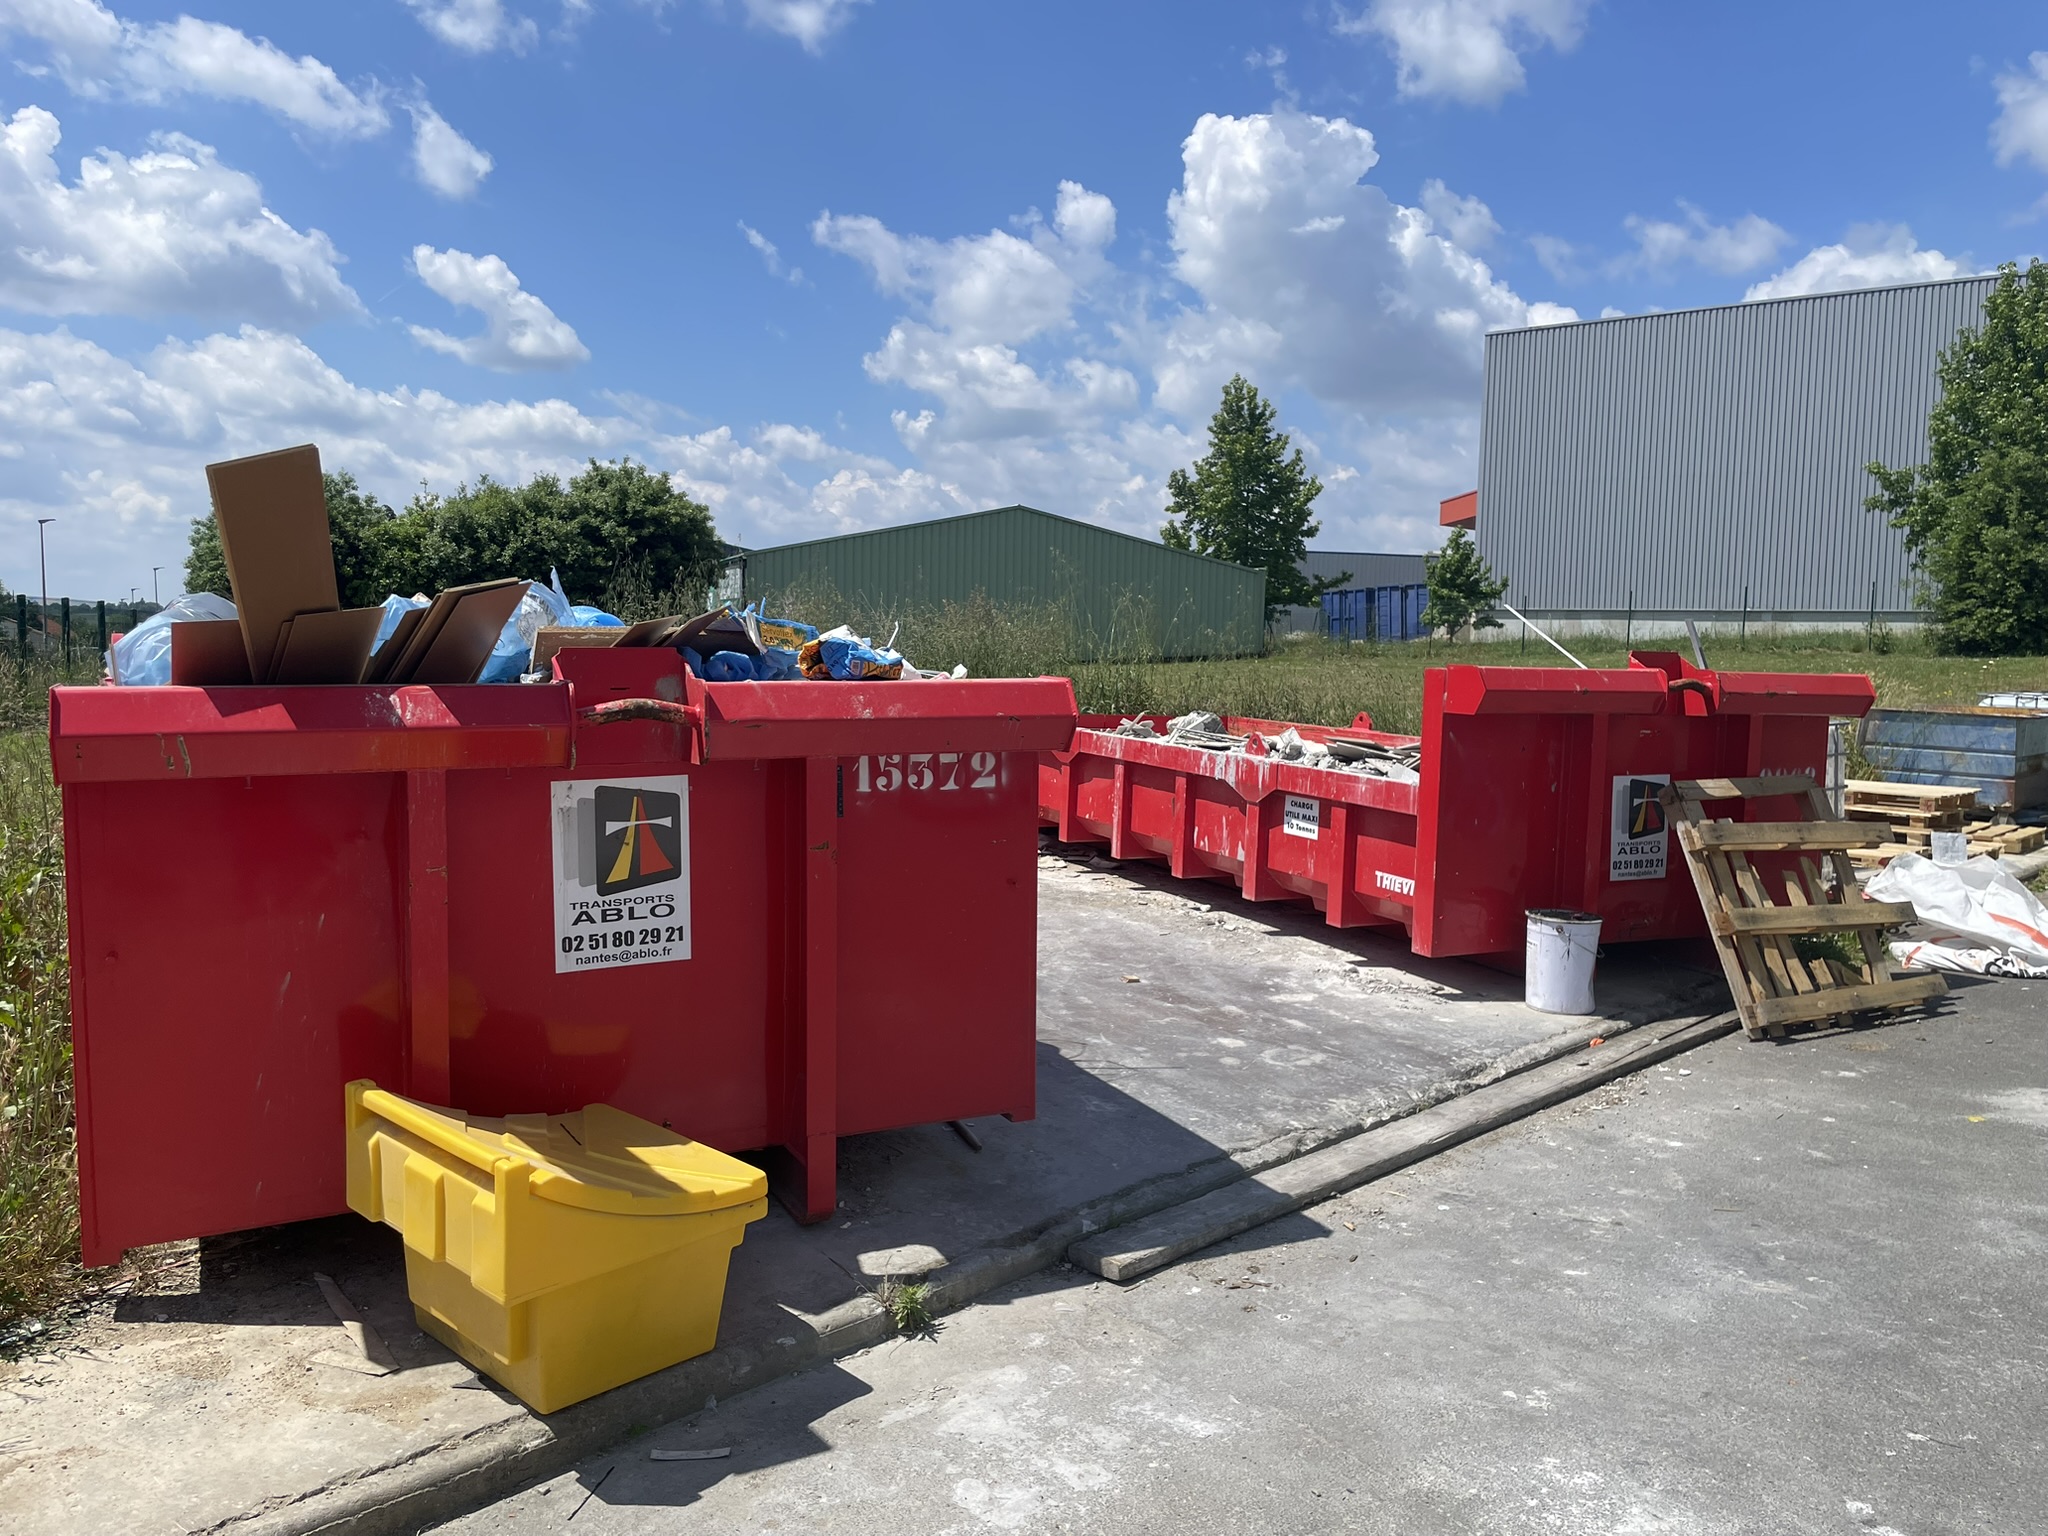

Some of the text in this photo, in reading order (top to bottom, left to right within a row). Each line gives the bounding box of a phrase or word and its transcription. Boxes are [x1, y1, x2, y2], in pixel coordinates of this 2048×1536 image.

[852, 751, 996, 793] 15372
[1290, 800, 1314, 811] CHARGE
[1285, 810, 1318, 823] UTILE MAXI
[1287, 821, 1316, 834] 10 Tonnes
[1617, 840, 1661, 848] TRANSPORTS
[1617, 845, 1661, 855] ABLO
[1612, 858, 1664, 870] 02 51 80 29 21
[569, 894, 675, 910] TRANSPORTS
[571, 903, 675, 926] ABLO
[561, 926, 684, 953] 02 51 80 29 21
[575, 946, 672, 965] nantes@ablo.fr
